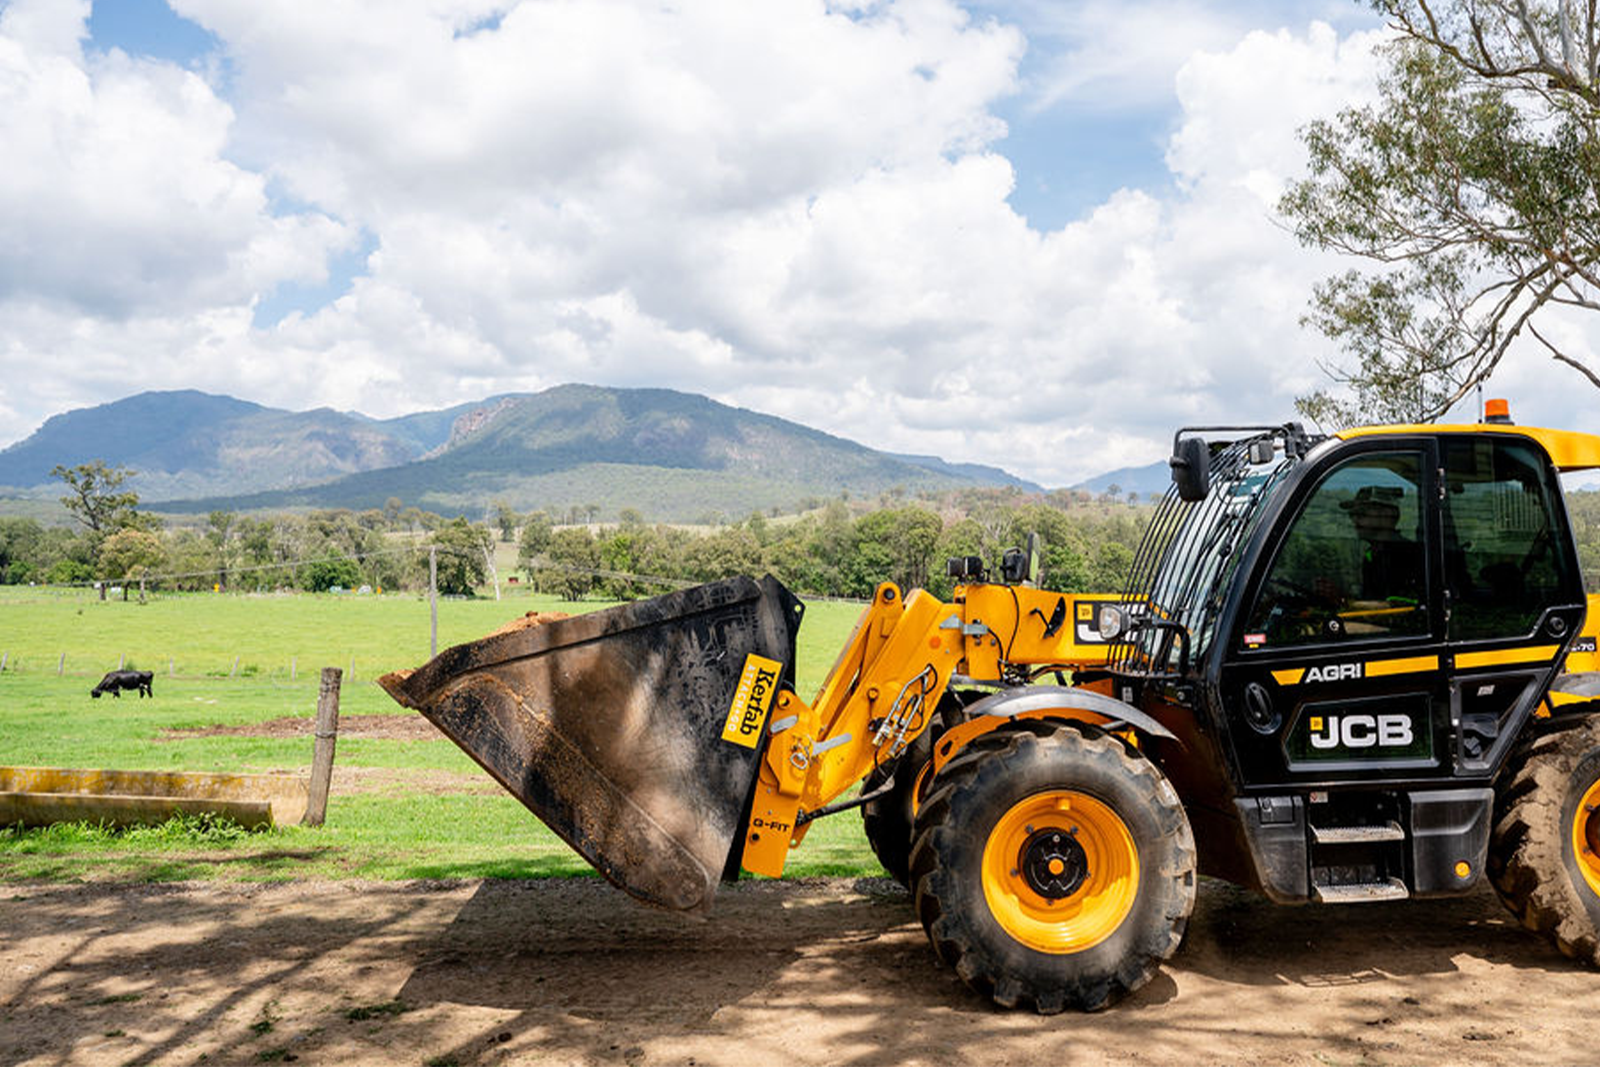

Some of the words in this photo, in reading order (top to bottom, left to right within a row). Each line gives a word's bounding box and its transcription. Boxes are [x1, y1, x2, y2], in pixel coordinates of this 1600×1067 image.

[1305, 663, 1361, 683] AGRI
[740, 668, 776, 735] Kerfab
[1310, 714, 1413, 748] JCB
[753, 818, 790, 832] Q-FIT
